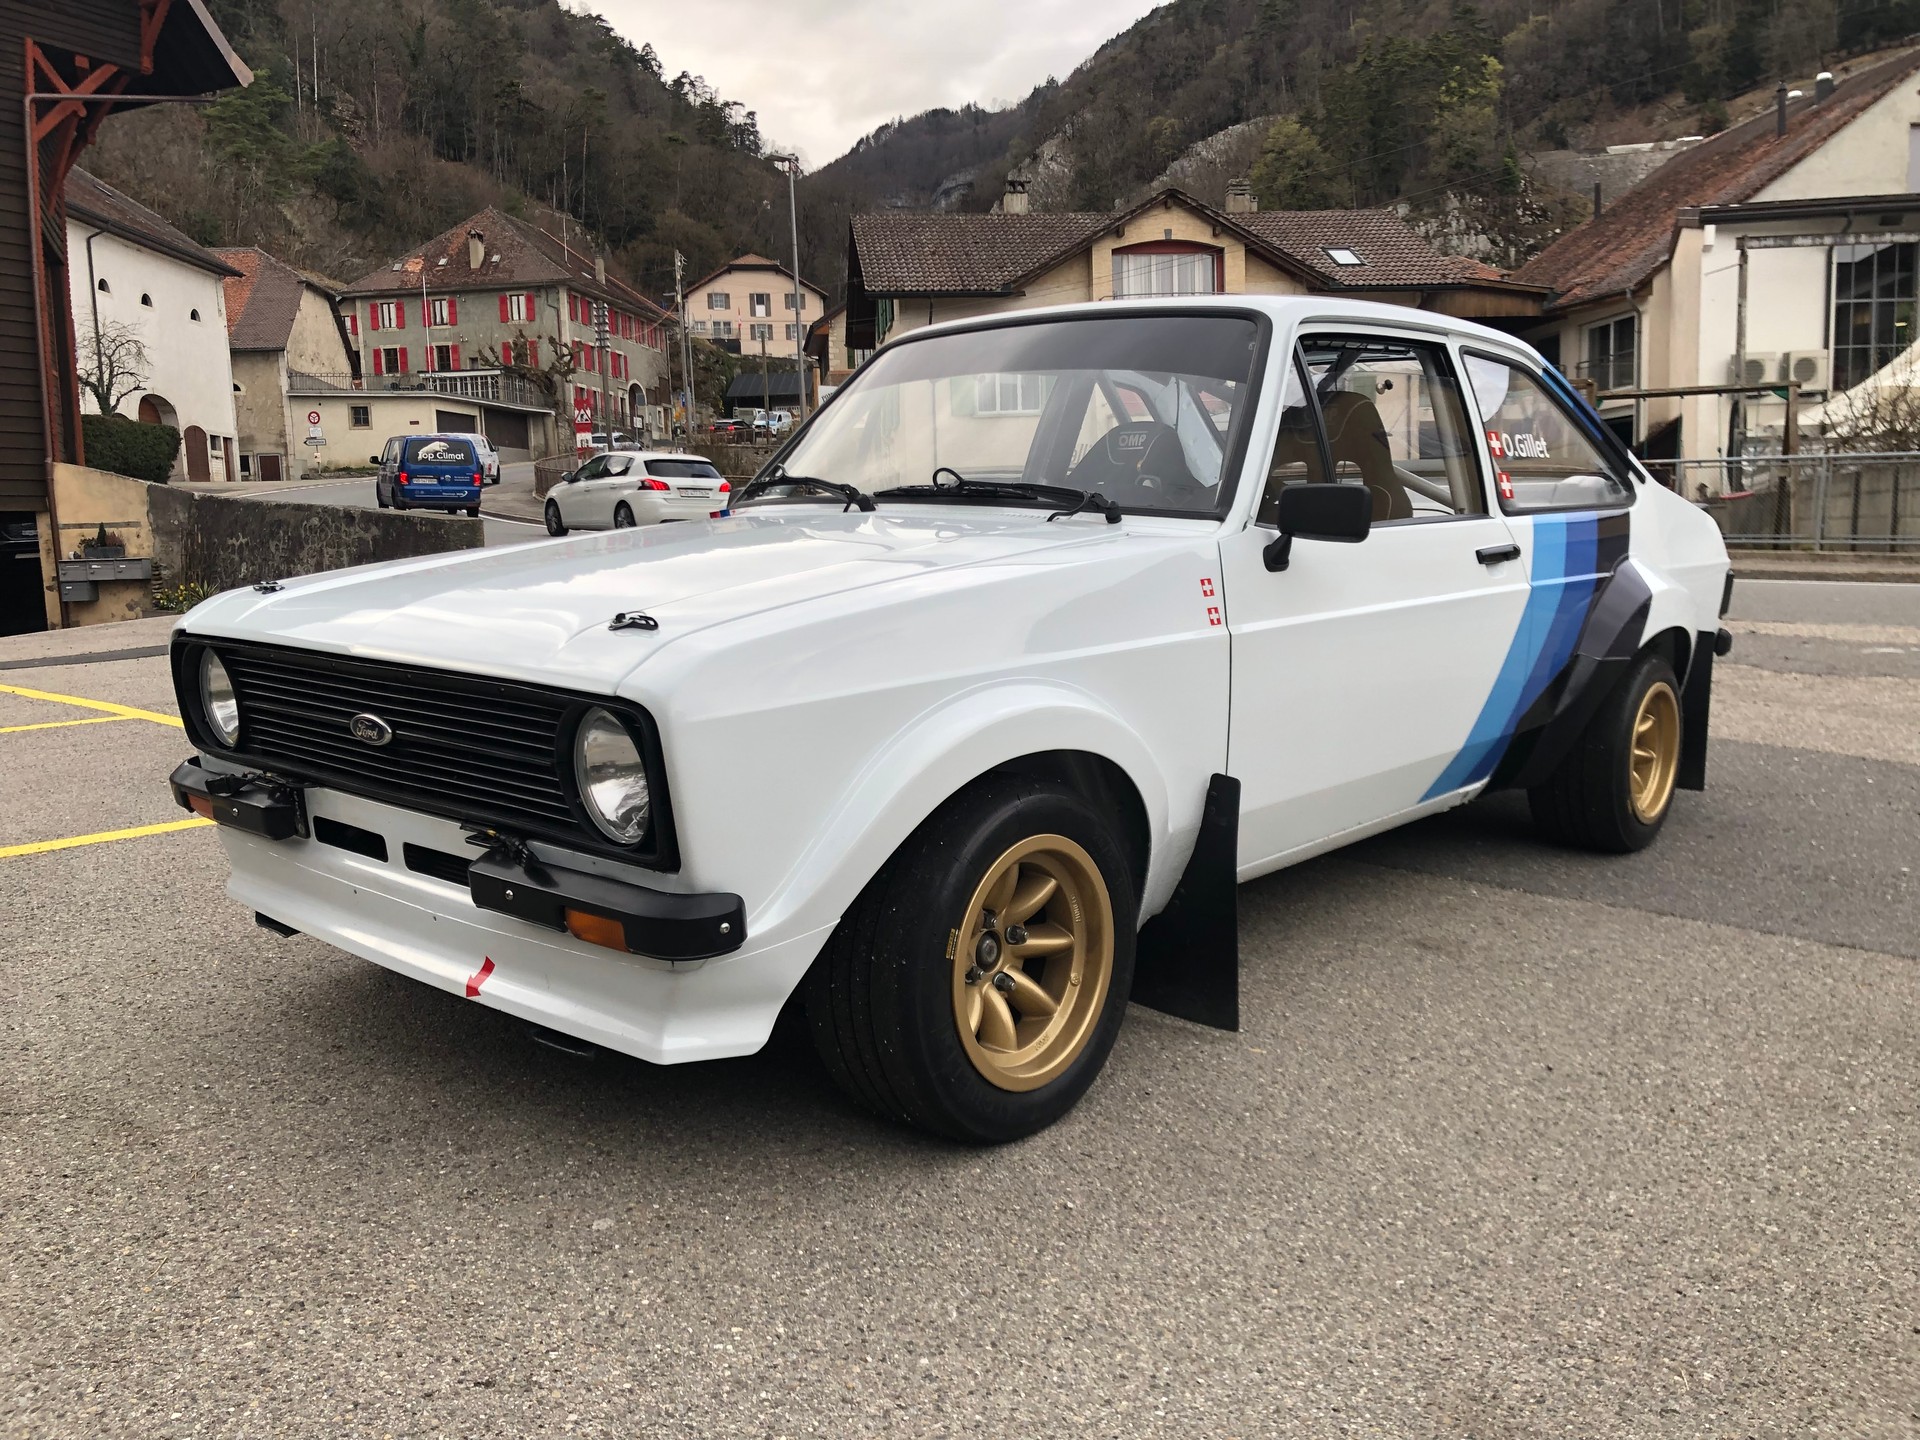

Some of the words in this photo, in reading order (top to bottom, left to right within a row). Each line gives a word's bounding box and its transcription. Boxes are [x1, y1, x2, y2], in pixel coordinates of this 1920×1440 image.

[1118, 434, 1147, 447] OMP
[1502, 433, 1550, 458] O.Gillet
[417, 451, 435, 461] Top
[436, 451, 465, 460] Climat
[356, 719, 379, 740] Ford
